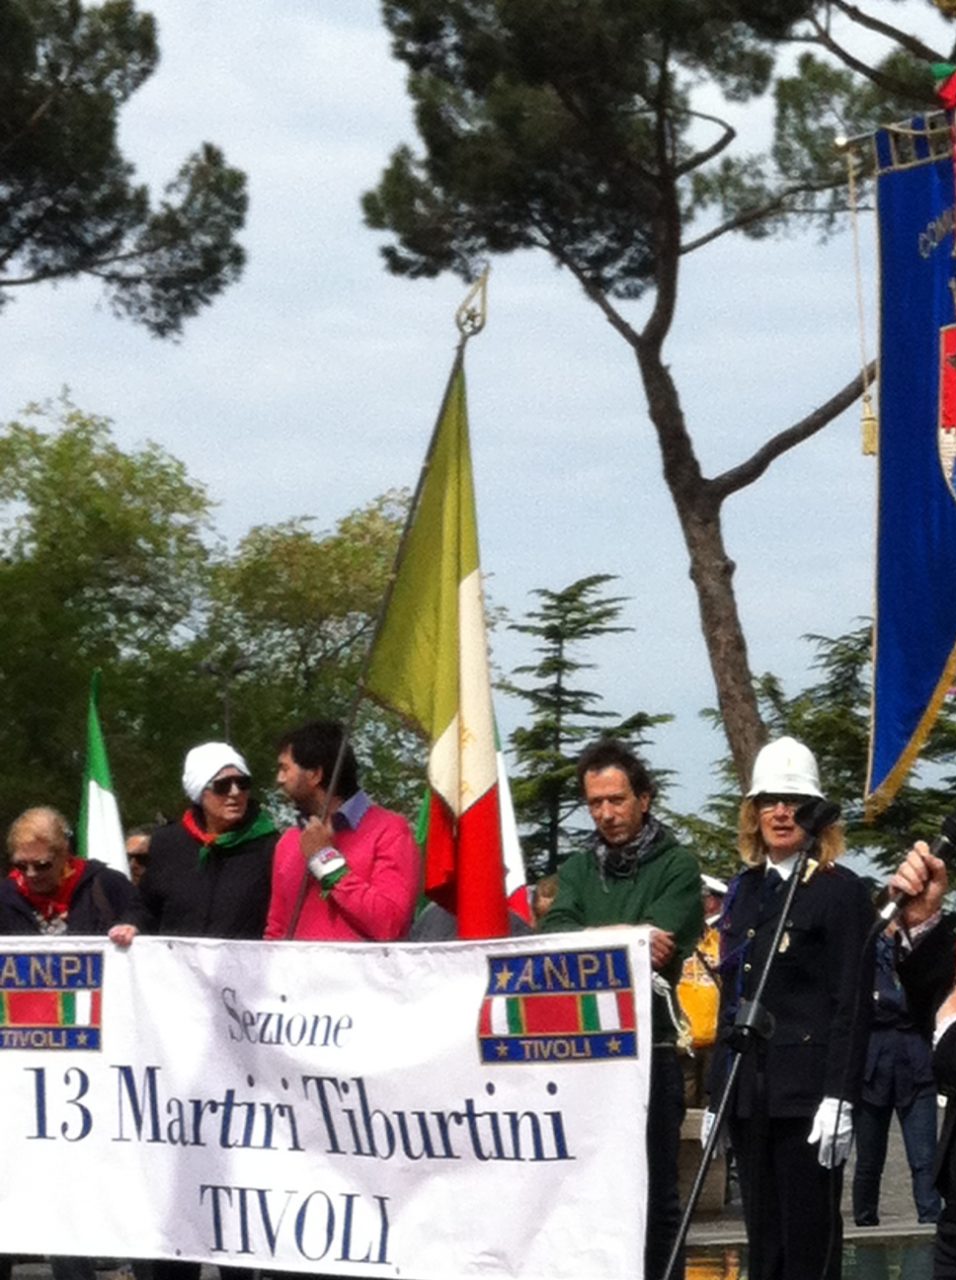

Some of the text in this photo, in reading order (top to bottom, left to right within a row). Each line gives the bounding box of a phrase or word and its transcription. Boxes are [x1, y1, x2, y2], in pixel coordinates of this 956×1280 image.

[1, 1029, 67, 1048] TIVOLI
[221, 987, 353, 1048] Sezione
[519, 1037, 592, 1060] TIVOLI
[23, 1064, 577, 1162] 13 Martiri Tiburtini
[199, 1184, 392, 1265] TIVOLI
